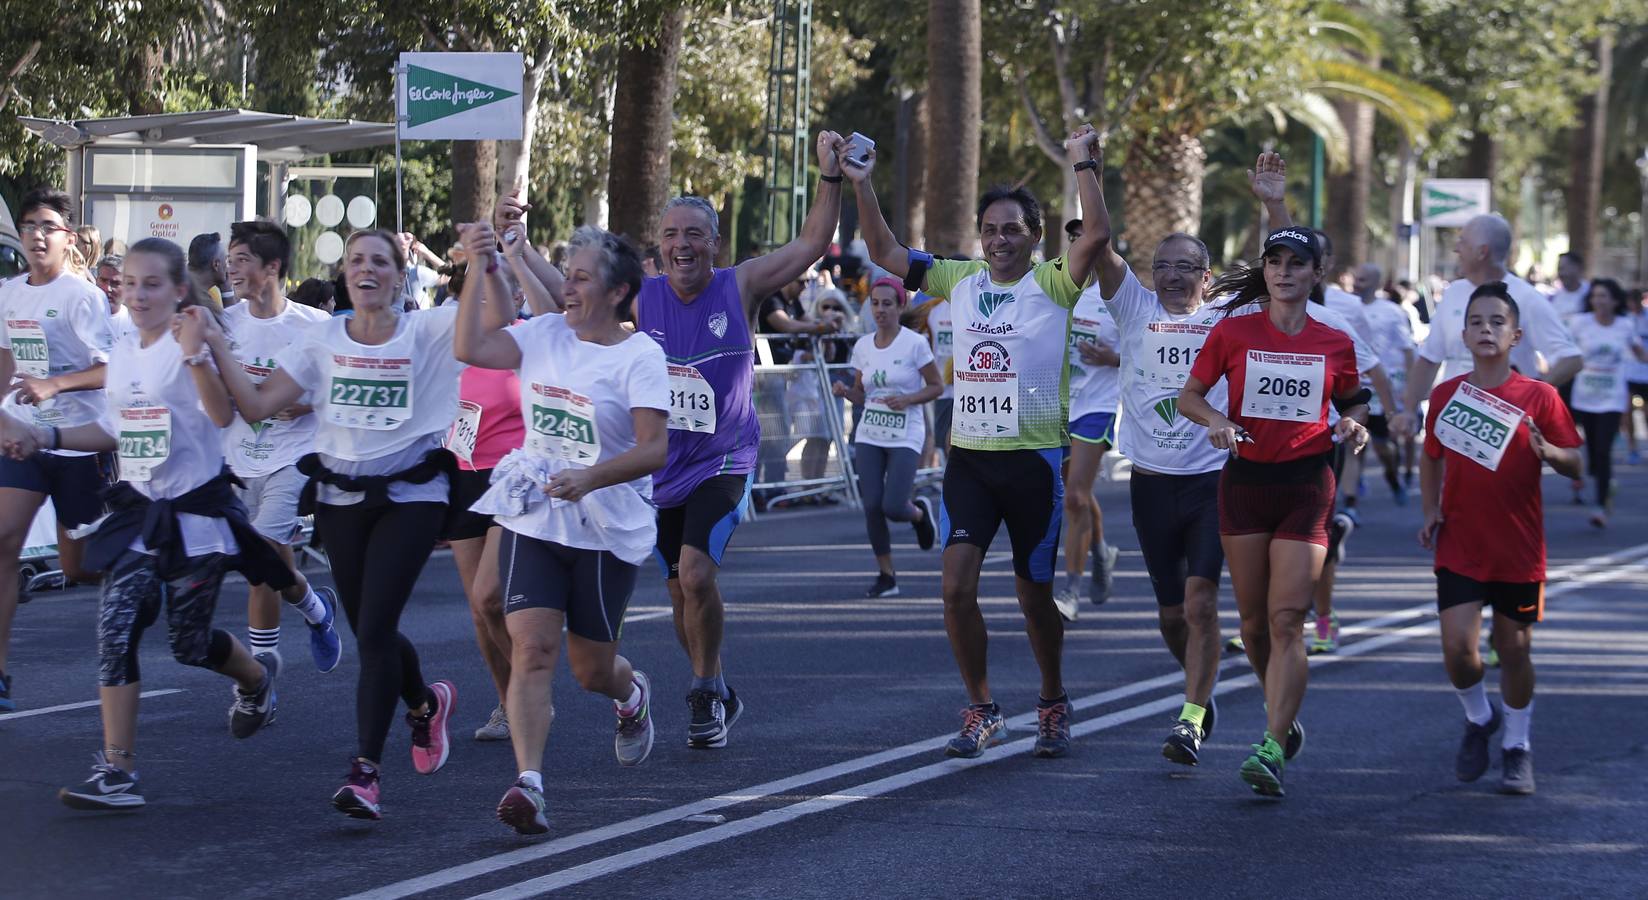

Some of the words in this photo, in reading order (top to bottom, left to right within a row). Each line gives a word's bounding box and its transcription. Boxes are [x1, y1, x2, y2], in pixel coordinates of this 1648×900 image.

[150, 222, 180, 230] General
[1269, 230, 1308, 243] adidas
[971, 322, 1014, 335] Unicaja
[13, 343, 47, 360] 21103
[977, 351, 992, 370] 38
[992, 352, 1001, 361] CA
[1157, 346, 1202, 365] 181
[1249, 351, 1263, 363] 41
[332, 383, 405, 406] 22737
[1257, 376, 1311, 398] 2068
[960, 395, 1013, 414] 18114
[534, 411, 590, 443] 22451
[866, 411, 904, 428] 20099
[1443, 406, 1506, 447] 20285
[121, 436, 168, 457] 22734
[1157, 440, 1187, 450] Unicaja
